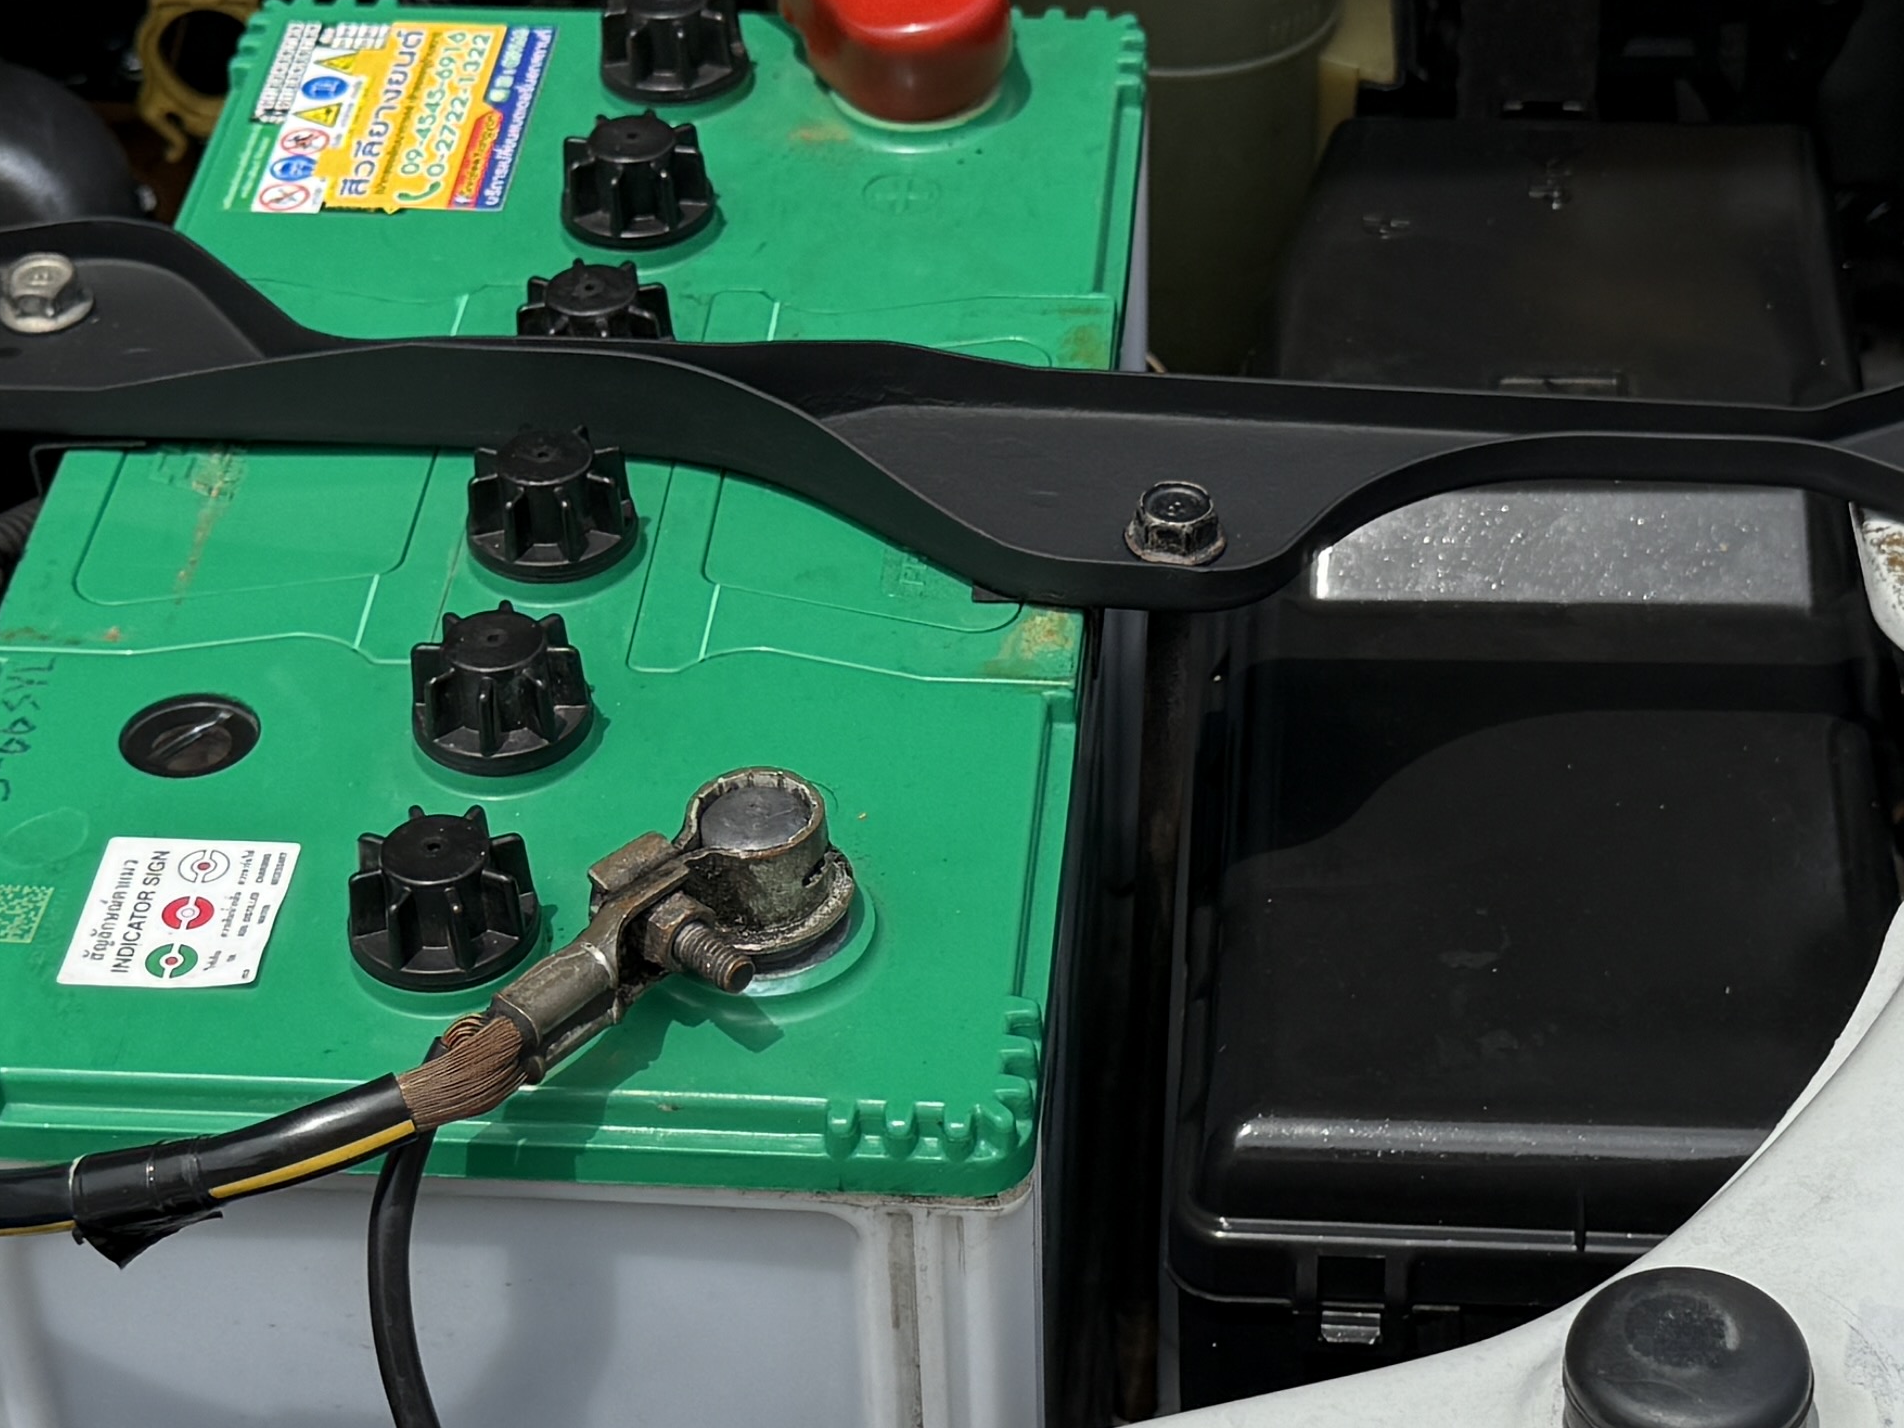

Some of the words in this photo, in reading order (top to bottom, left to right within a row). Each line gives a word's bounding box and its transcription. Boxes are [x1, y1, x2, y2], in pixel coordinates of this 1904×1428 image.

[399, 30, 466, 176] 09-4545-6916
[426, 33, 491, 178] 0-2722-1322
[110, 890, 156, 973] INDICATOR
[145, 850, 171, 888] SIGN
